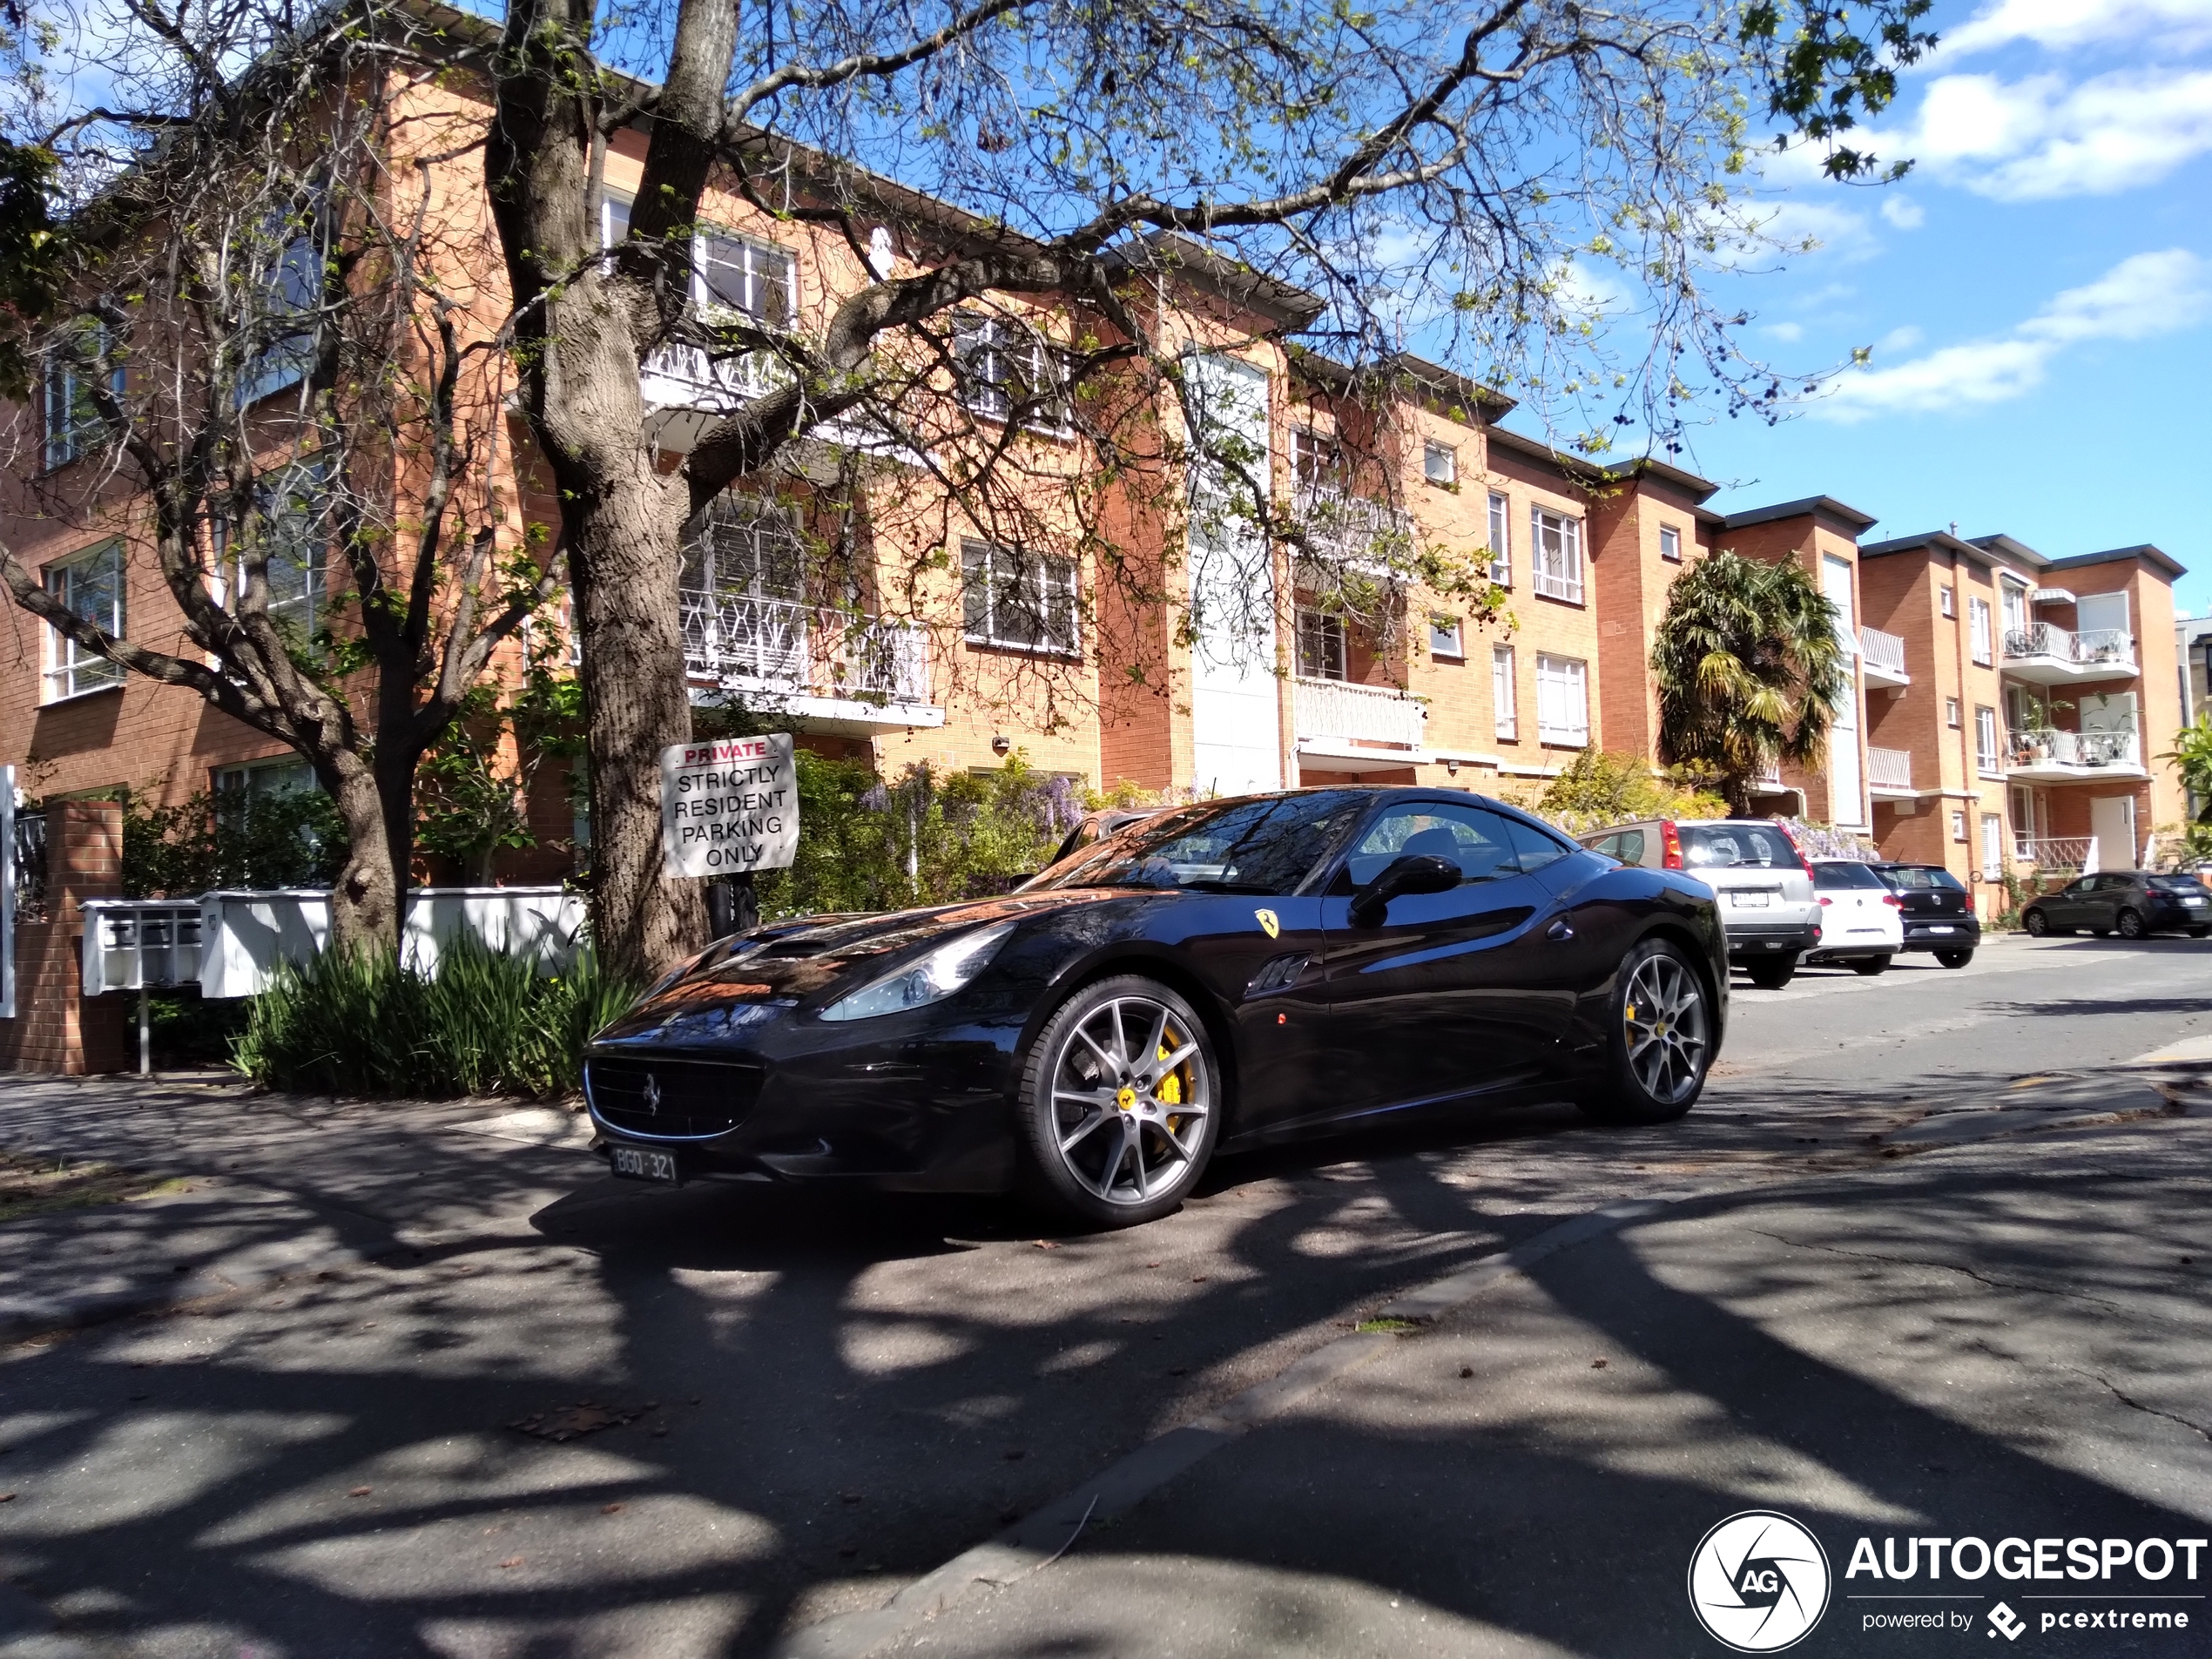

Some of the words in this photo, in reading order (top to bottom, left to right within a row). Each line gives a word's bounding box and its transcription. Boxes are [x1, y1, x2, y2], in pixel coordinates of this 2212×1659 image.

[685, 742, 766, 763] PRIVATE
[678, 765, 779, 792] STRICTLY
[674, 790, 786, 819] RESIDENT
[683, 816, 782, 844] PARKING
[706, 844, 763, 867] ONLY
